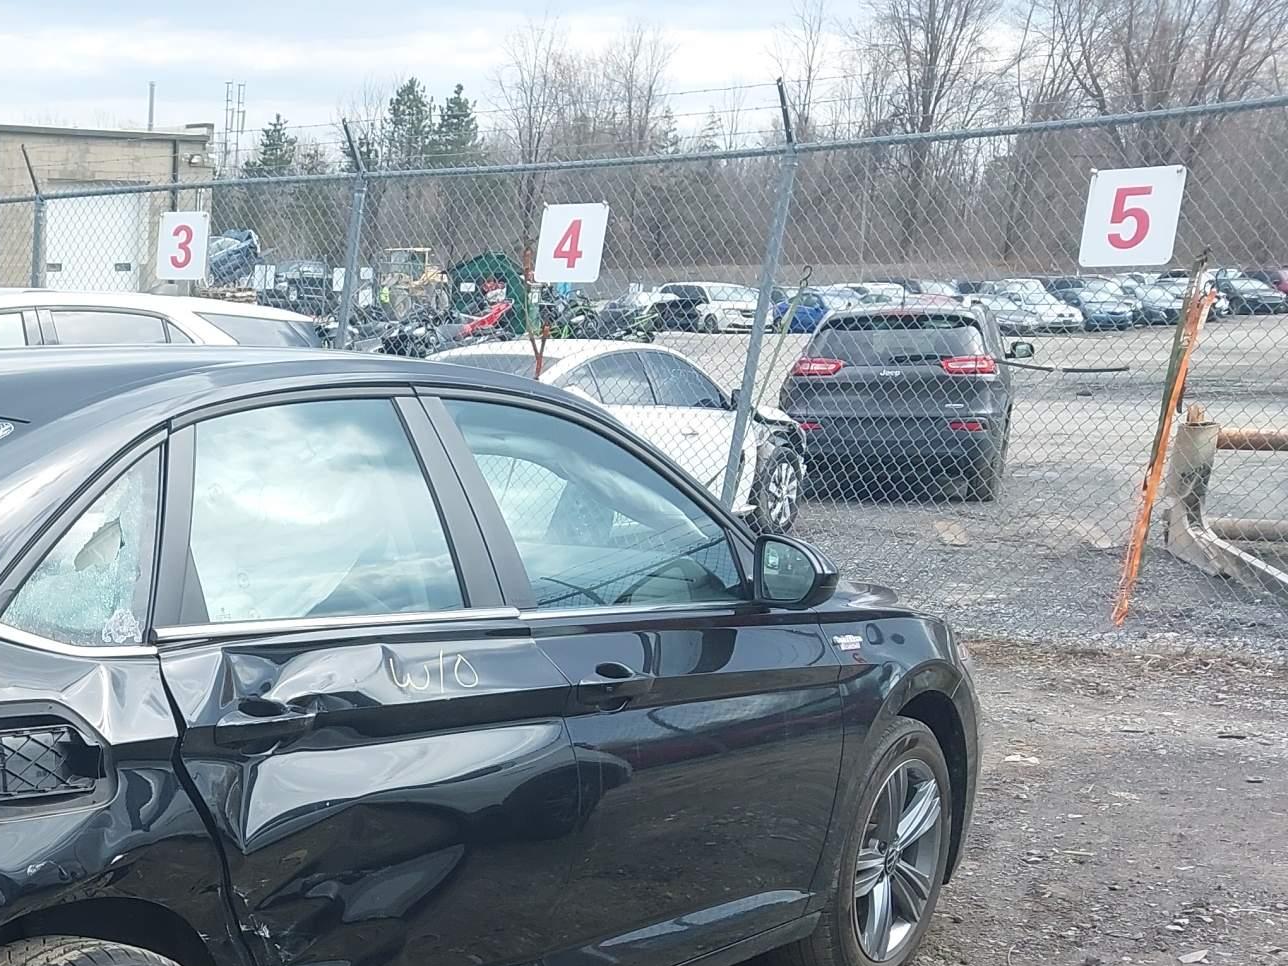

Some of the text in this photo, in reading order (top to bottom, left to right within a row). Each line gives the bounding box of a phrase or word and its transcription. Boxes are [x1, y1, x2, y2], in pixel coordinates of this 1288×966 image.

[1107, 185, 1153, 249] 5
[170, 224, 193, 269] 3
[553, 219, 583, 269] 4
